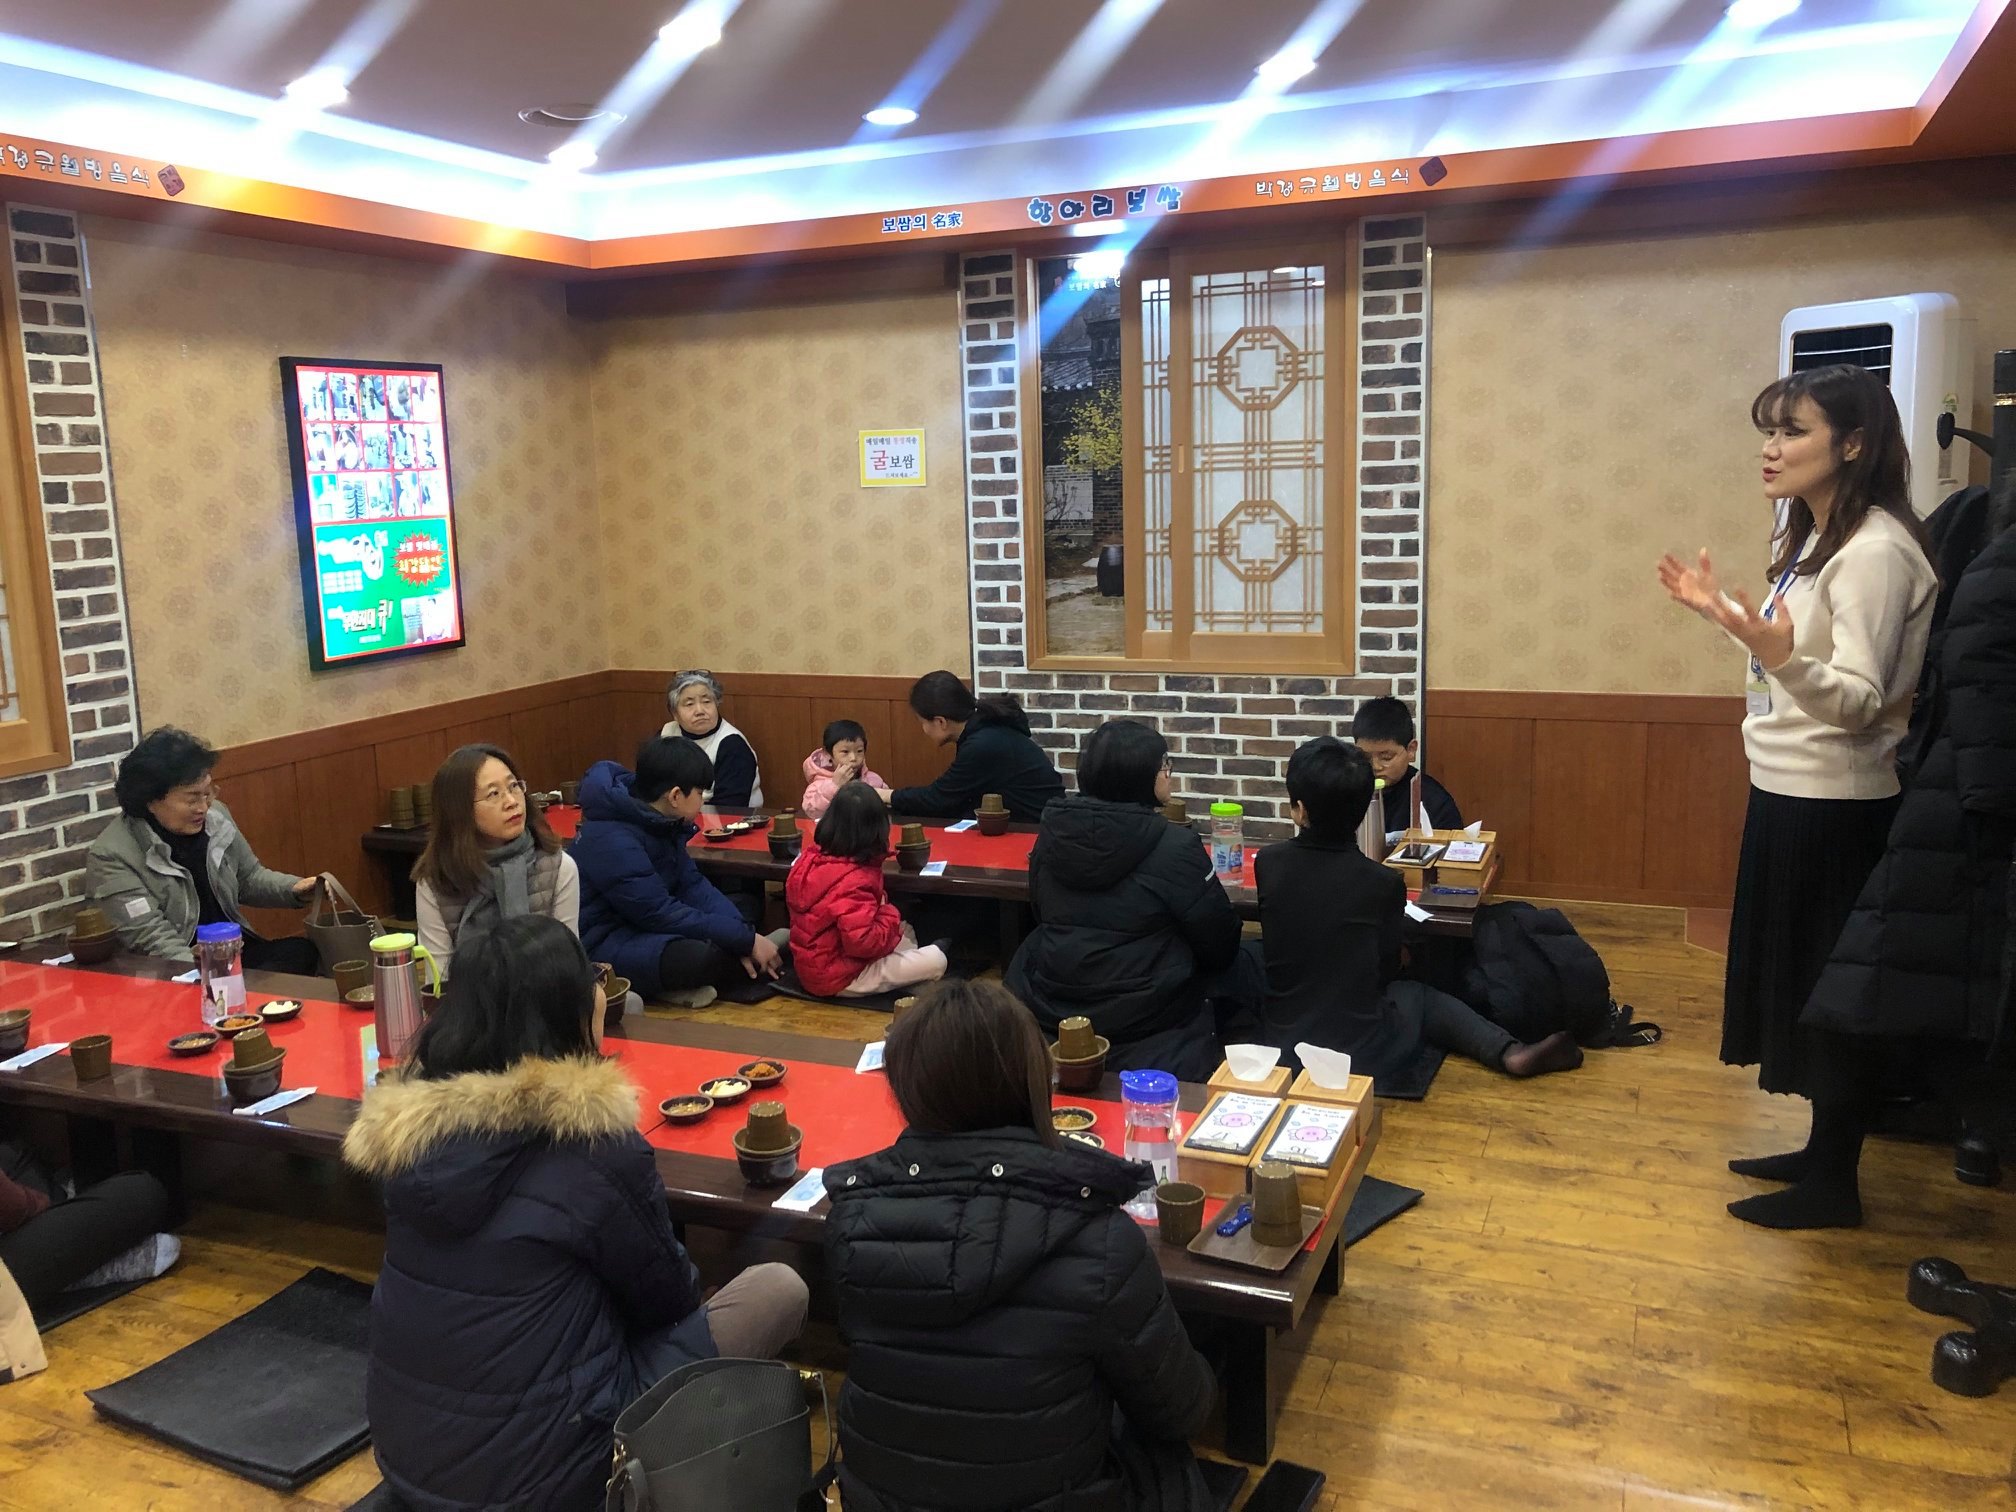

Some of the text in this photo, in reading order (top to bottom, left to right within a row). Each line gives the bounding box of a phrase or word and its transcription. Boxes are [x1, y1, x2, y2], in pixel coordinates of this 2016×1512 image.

[882, 210, 963, 233] 보쌈의 名家
[870, 449, 915, 470] 굴보쌈
